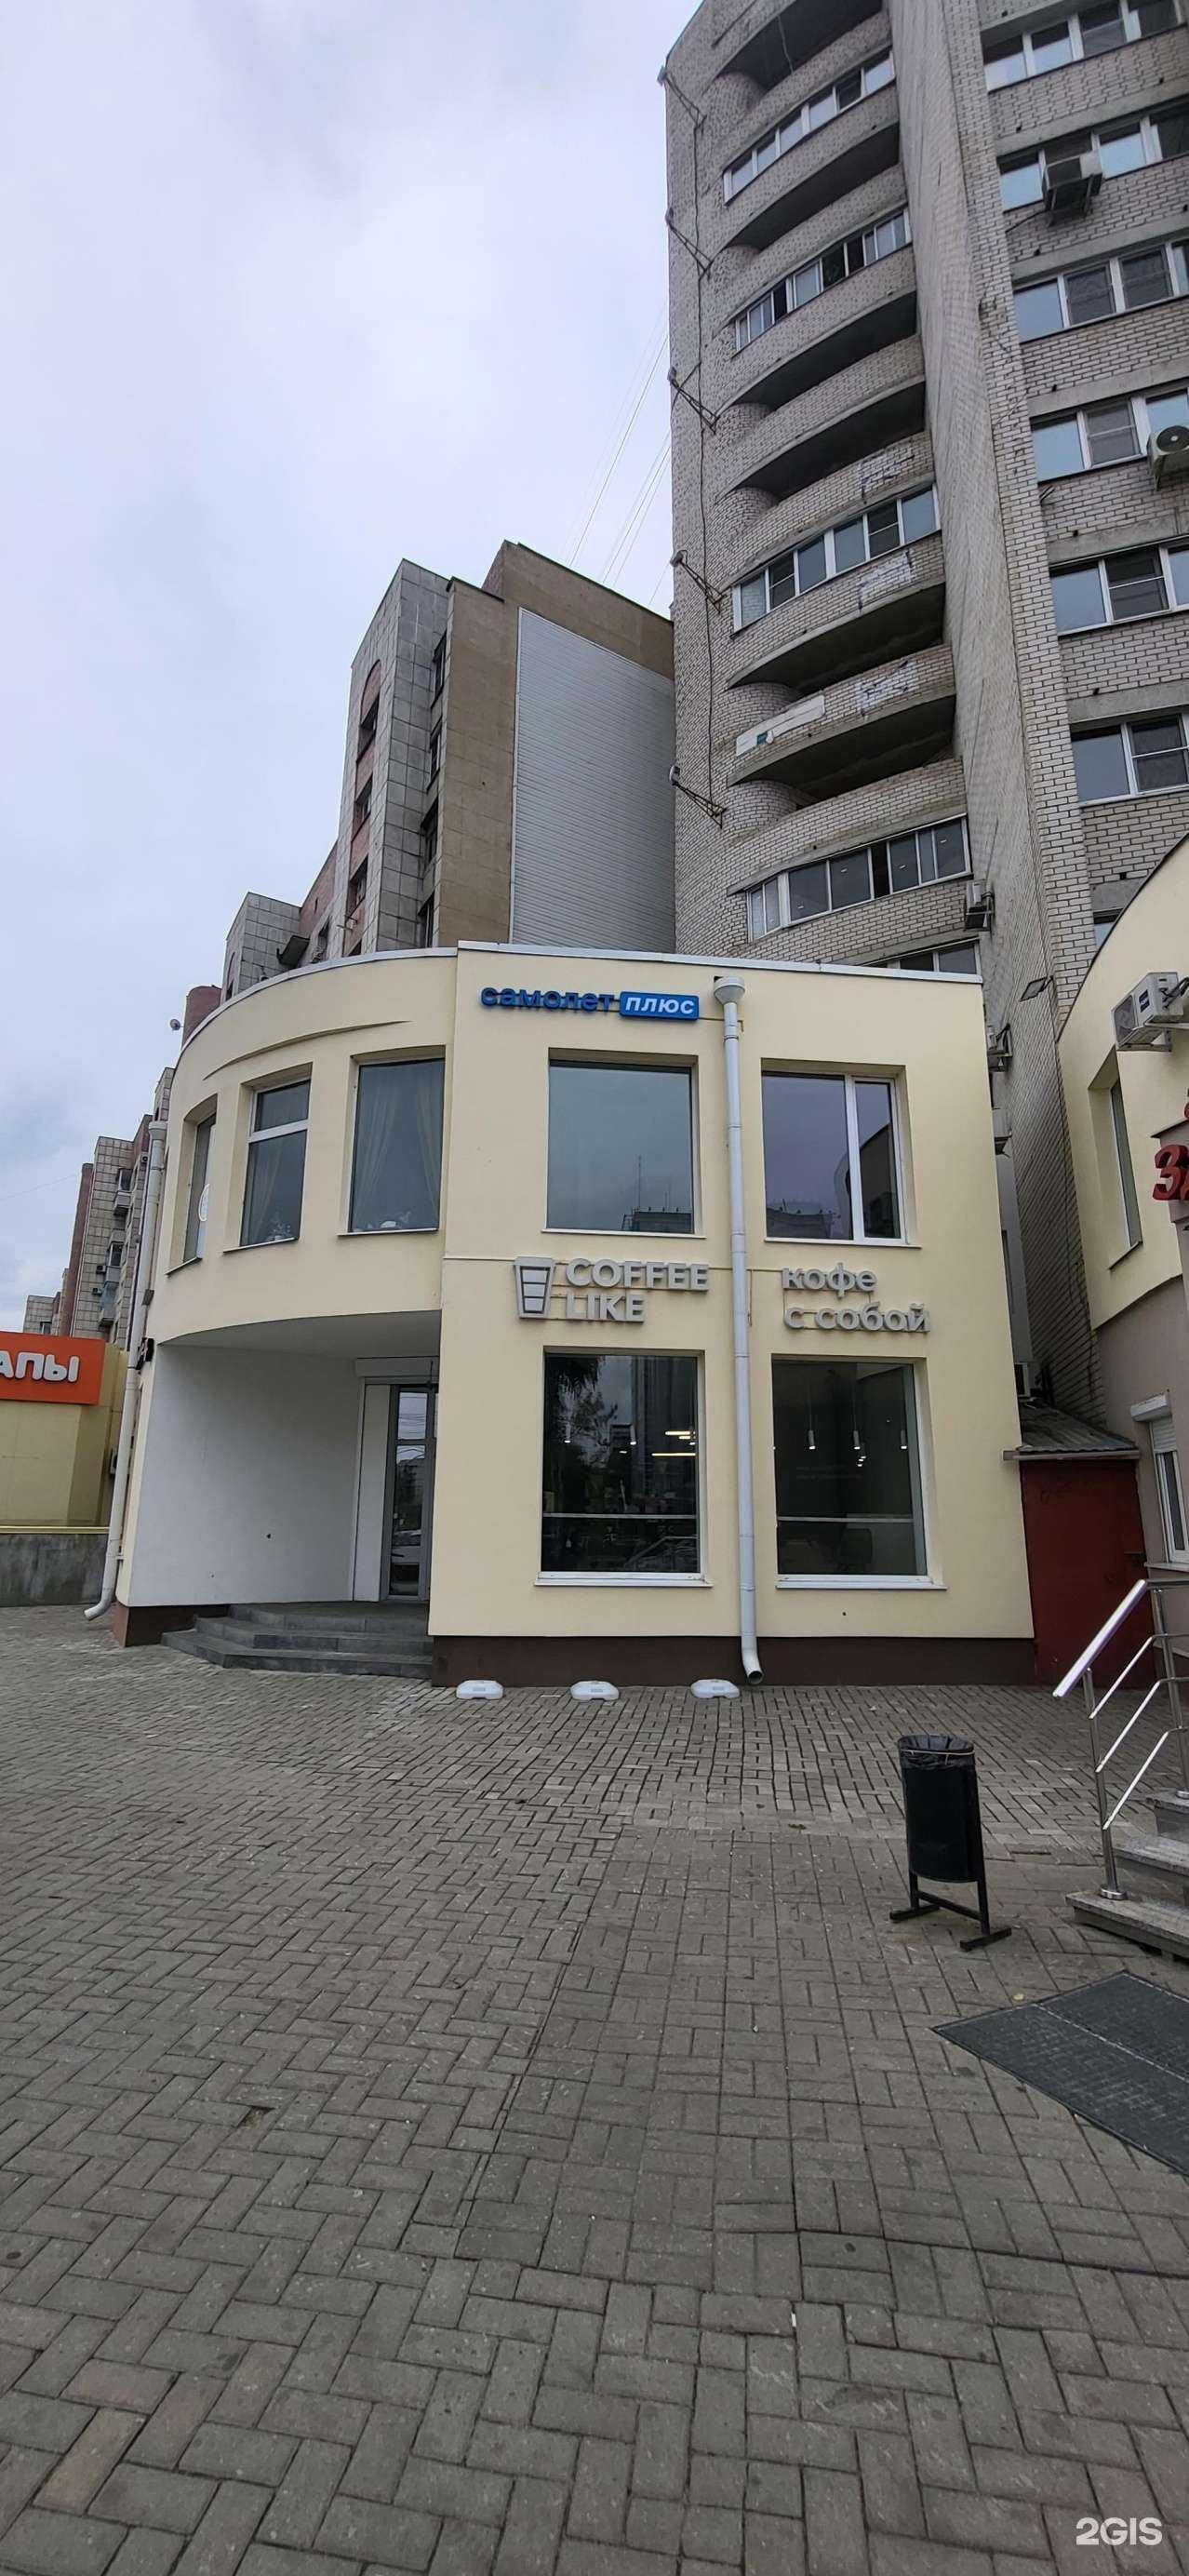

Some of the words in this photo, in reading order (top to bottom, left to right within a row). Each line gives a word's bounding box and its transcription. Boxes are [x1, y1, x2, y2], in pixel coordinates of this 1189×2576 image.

[481, 987, 614, 1013] самолет
[566, 1257, 710, 1291] COFFEE
[782, 1262, 877, 1299] кофе
[566, 1292, 644, 1322] LIKE
[783, 1307, 806, 1330] с
[815, 1302, 930, 1333] собой
